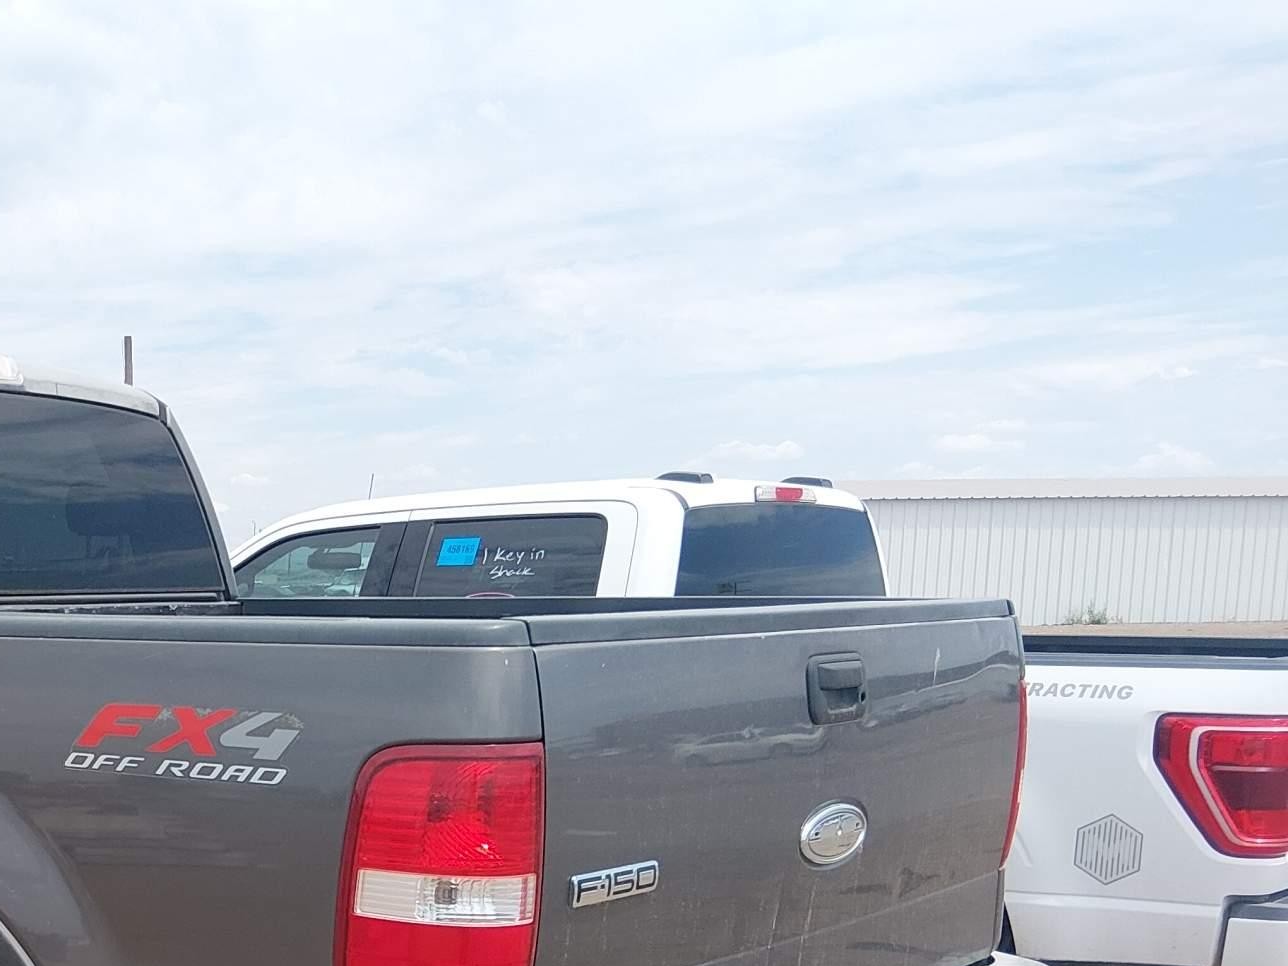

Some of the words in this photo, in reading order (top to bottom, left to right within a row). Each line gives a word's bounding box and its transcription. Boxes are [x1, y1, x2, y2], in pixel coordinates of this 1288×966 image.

[530, 547, 545, 560] in
[72, 702, 301, 761] FX4
[64, 752, 145, 772] OFF
[155, 759, 288, 785] ROAD
